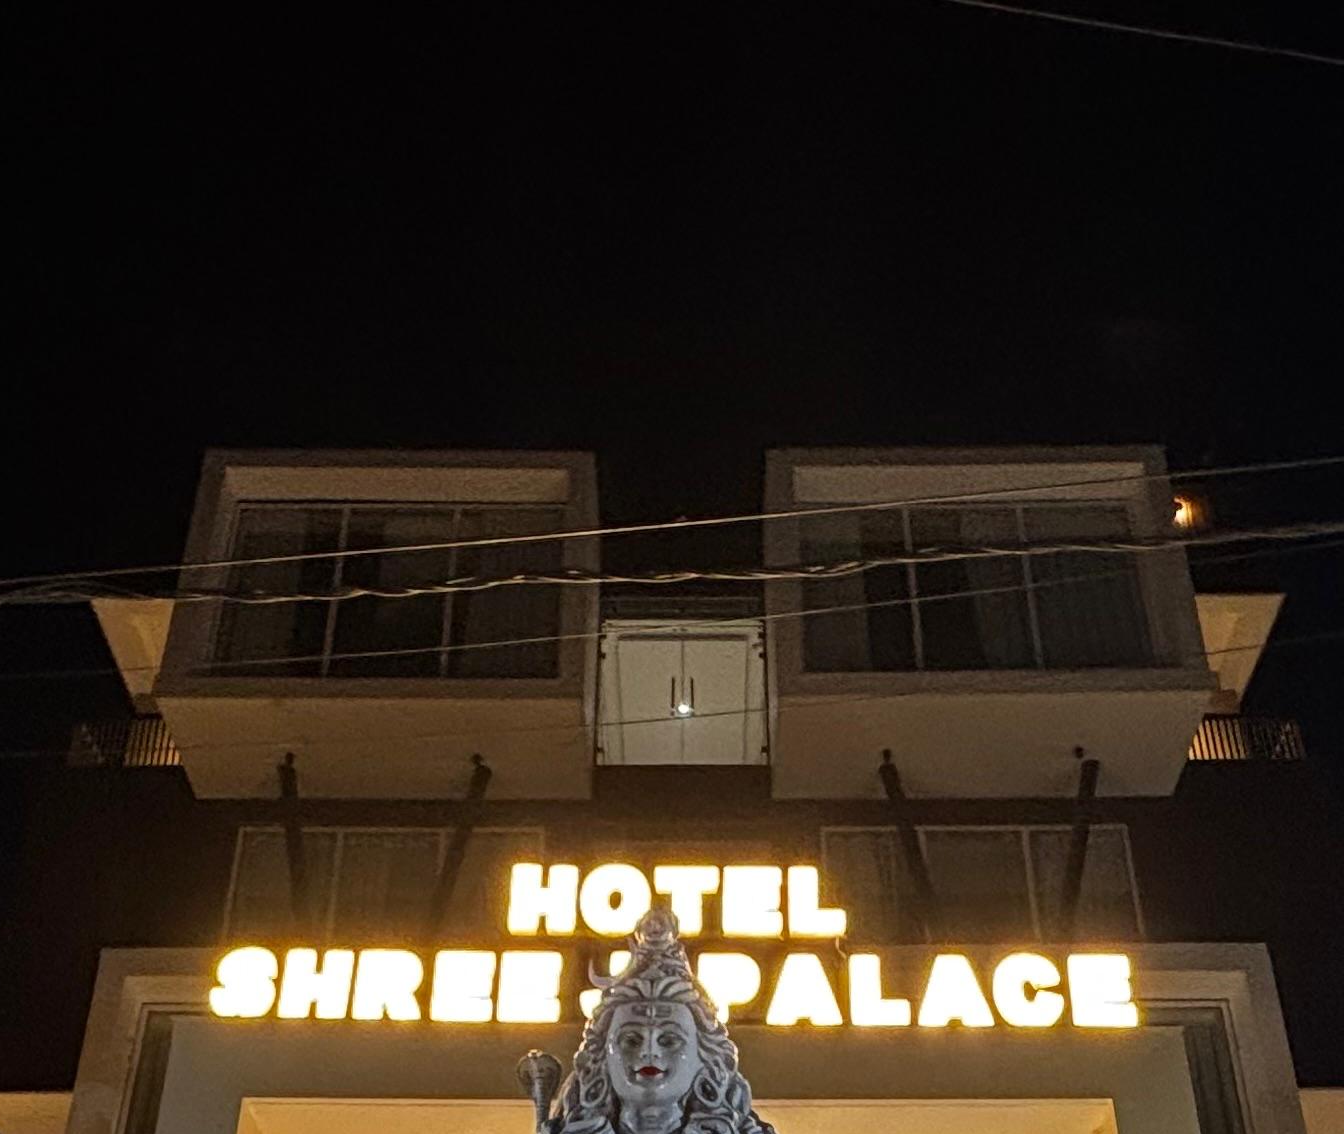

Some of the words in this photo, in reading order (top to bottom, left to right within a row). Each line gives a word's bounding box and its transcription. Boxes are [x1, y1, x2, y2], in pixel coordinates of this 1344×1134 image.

[507, 862, 847, 938] HOTEL
[208, 946, 564, 1024] SHREE
[696, 952, 1139, 1029] PALACE
